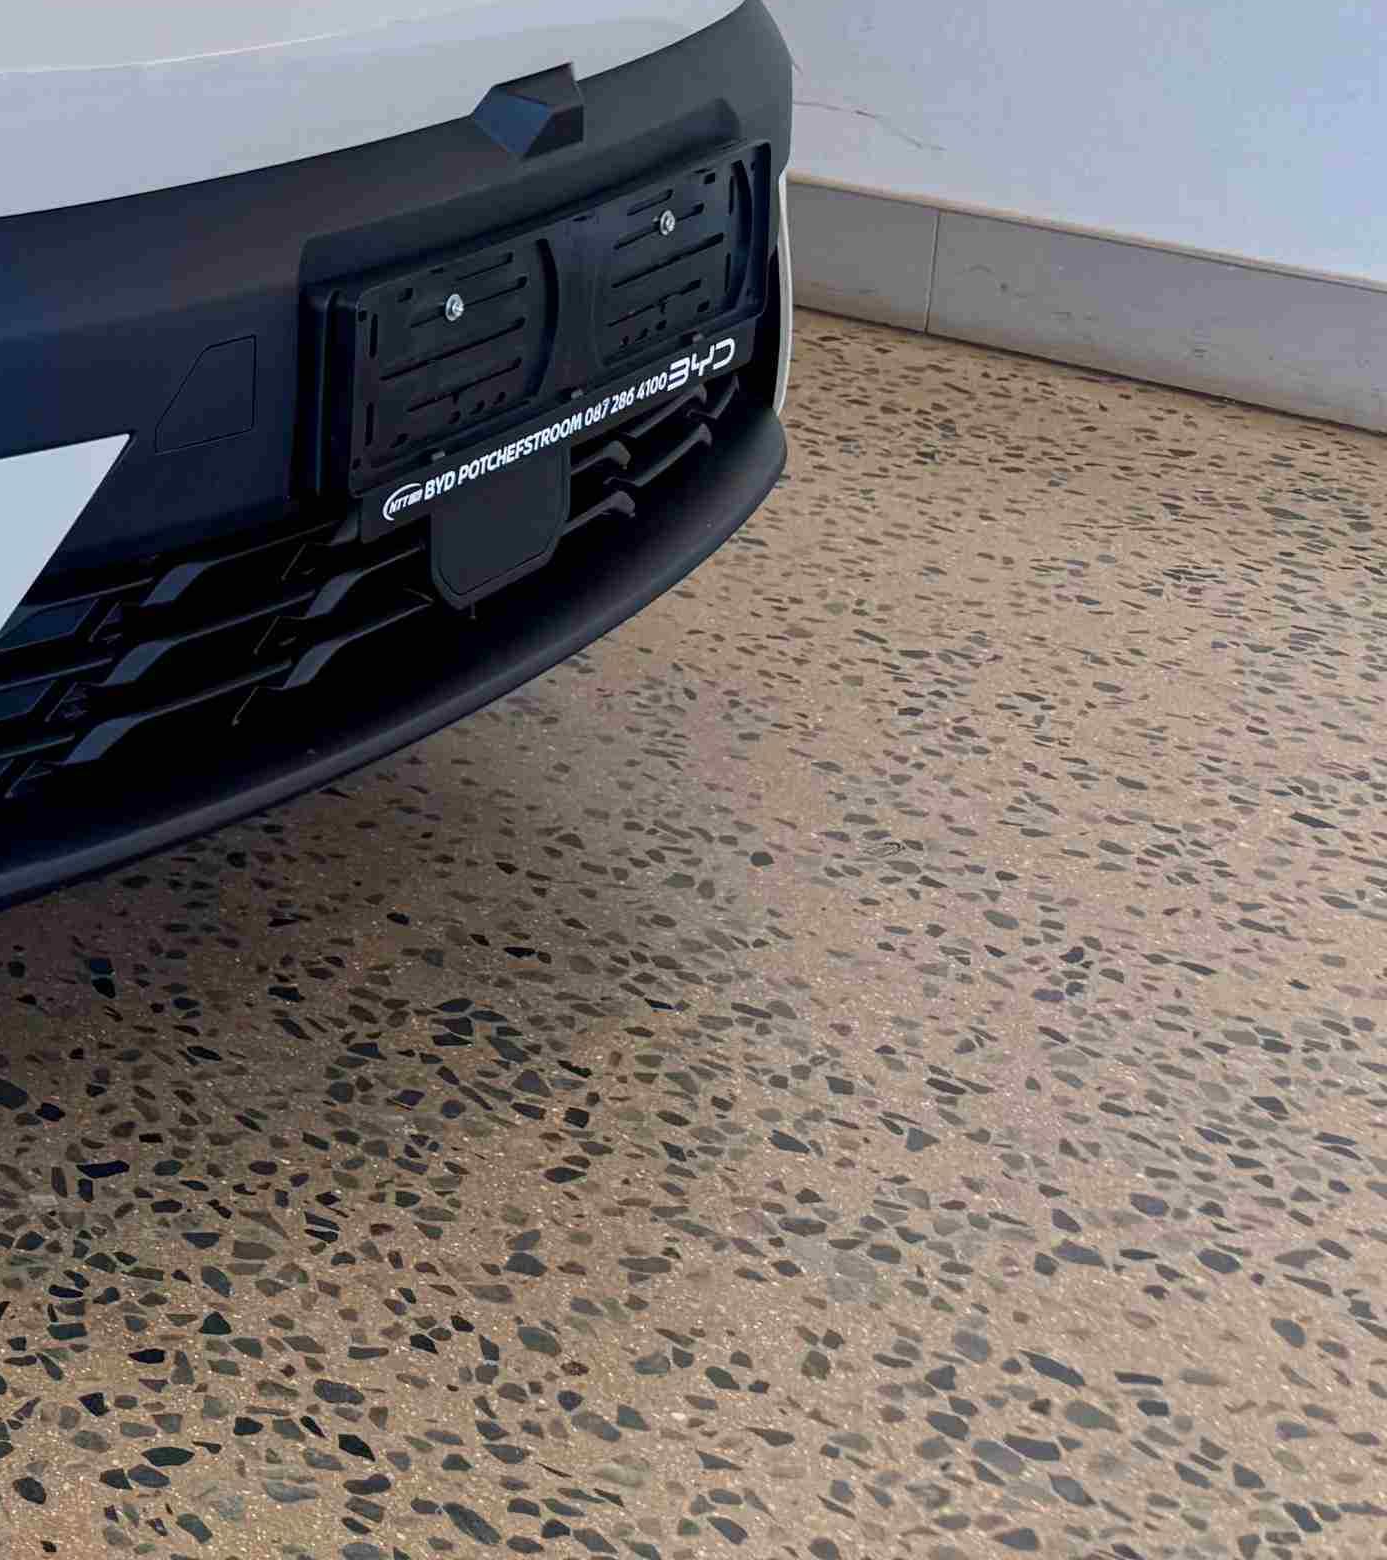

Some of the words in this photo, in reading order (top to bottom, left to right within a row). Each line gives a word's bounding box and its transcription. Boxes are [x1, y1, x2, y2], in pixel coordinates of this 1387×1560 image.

[667, 337, 736, 392] BYD
[423, 469, 457, 501] BYD
[457, 412, 583, 486] POTCHEFSTROOM
[584, 397, 611, 427] 087
[636, 371, 668, 400] 4100
